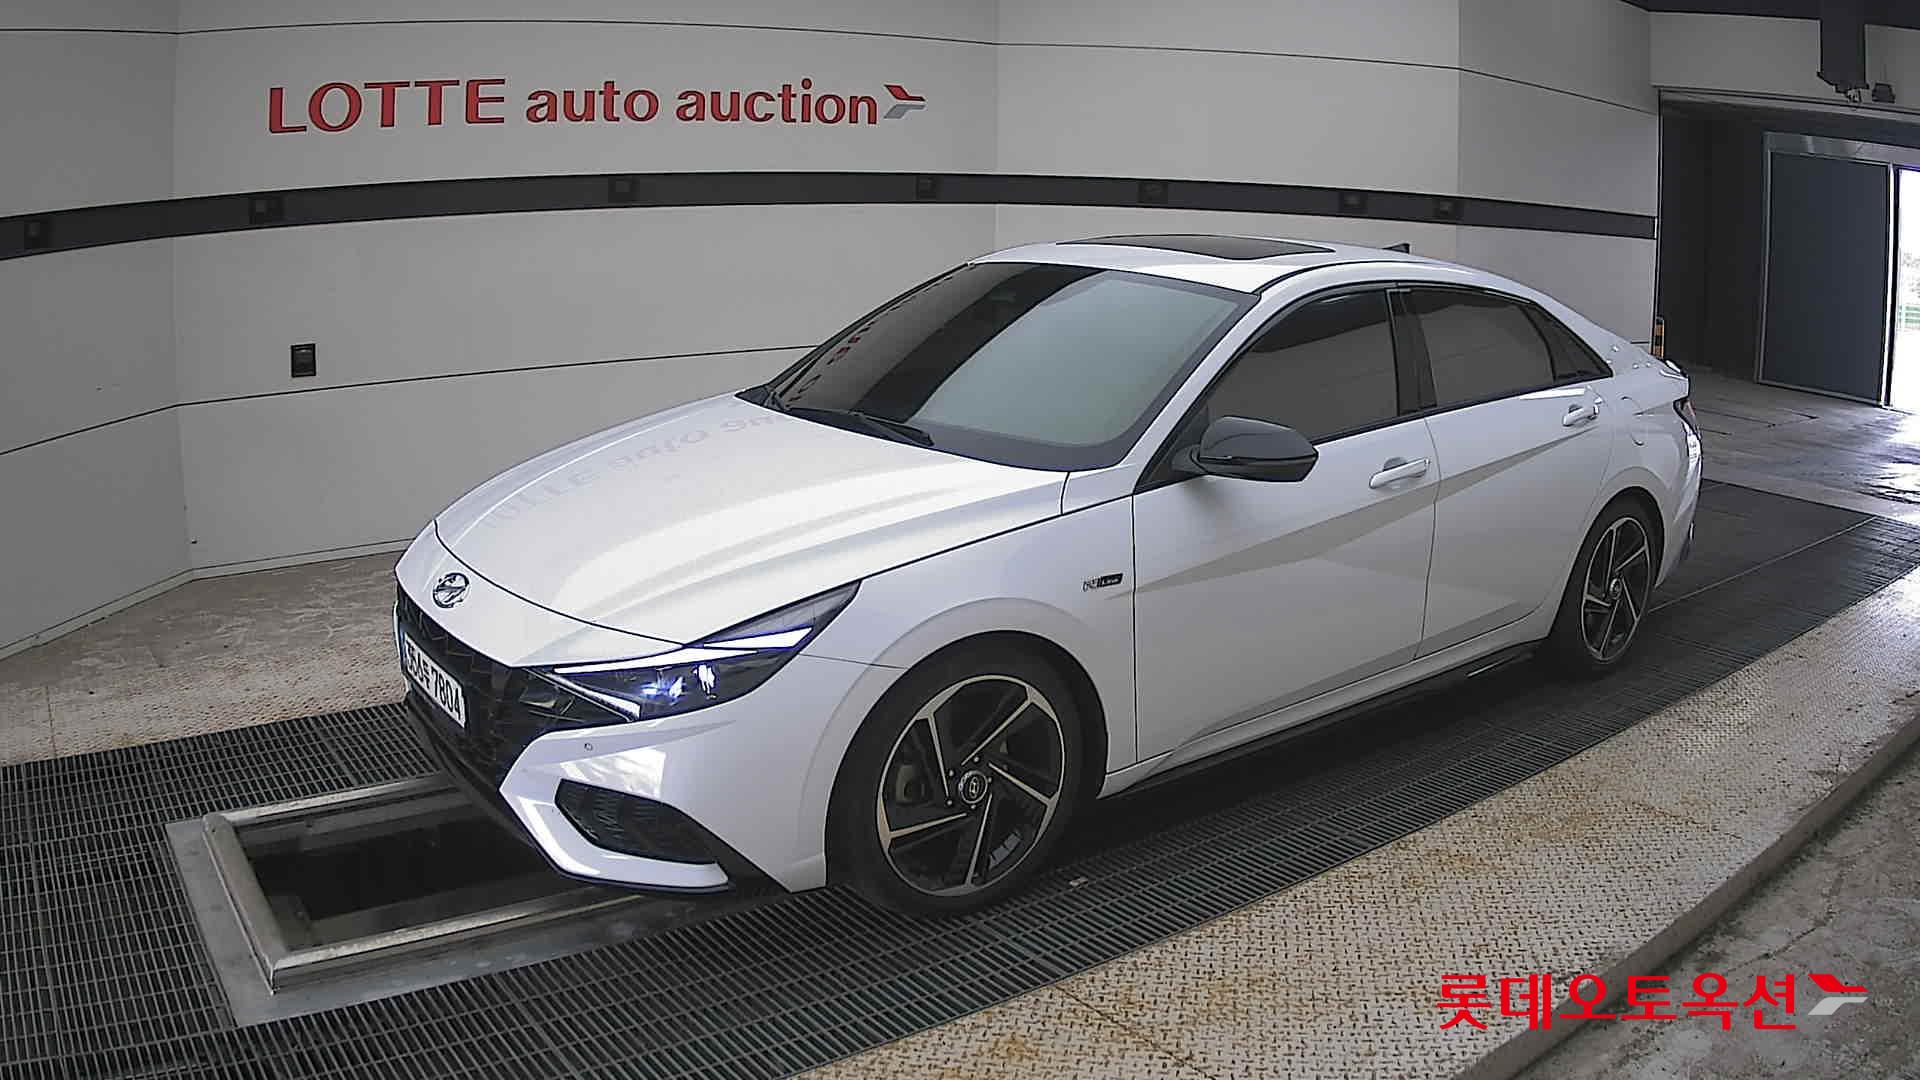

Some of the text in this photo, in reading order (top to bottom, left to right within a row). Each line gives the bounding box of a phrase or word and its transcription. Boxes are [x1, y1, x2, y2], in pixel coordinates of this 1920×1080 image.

[268, 79, 877, 133] LOTTE auto auction
[431, 668, 461, 721] 7804
